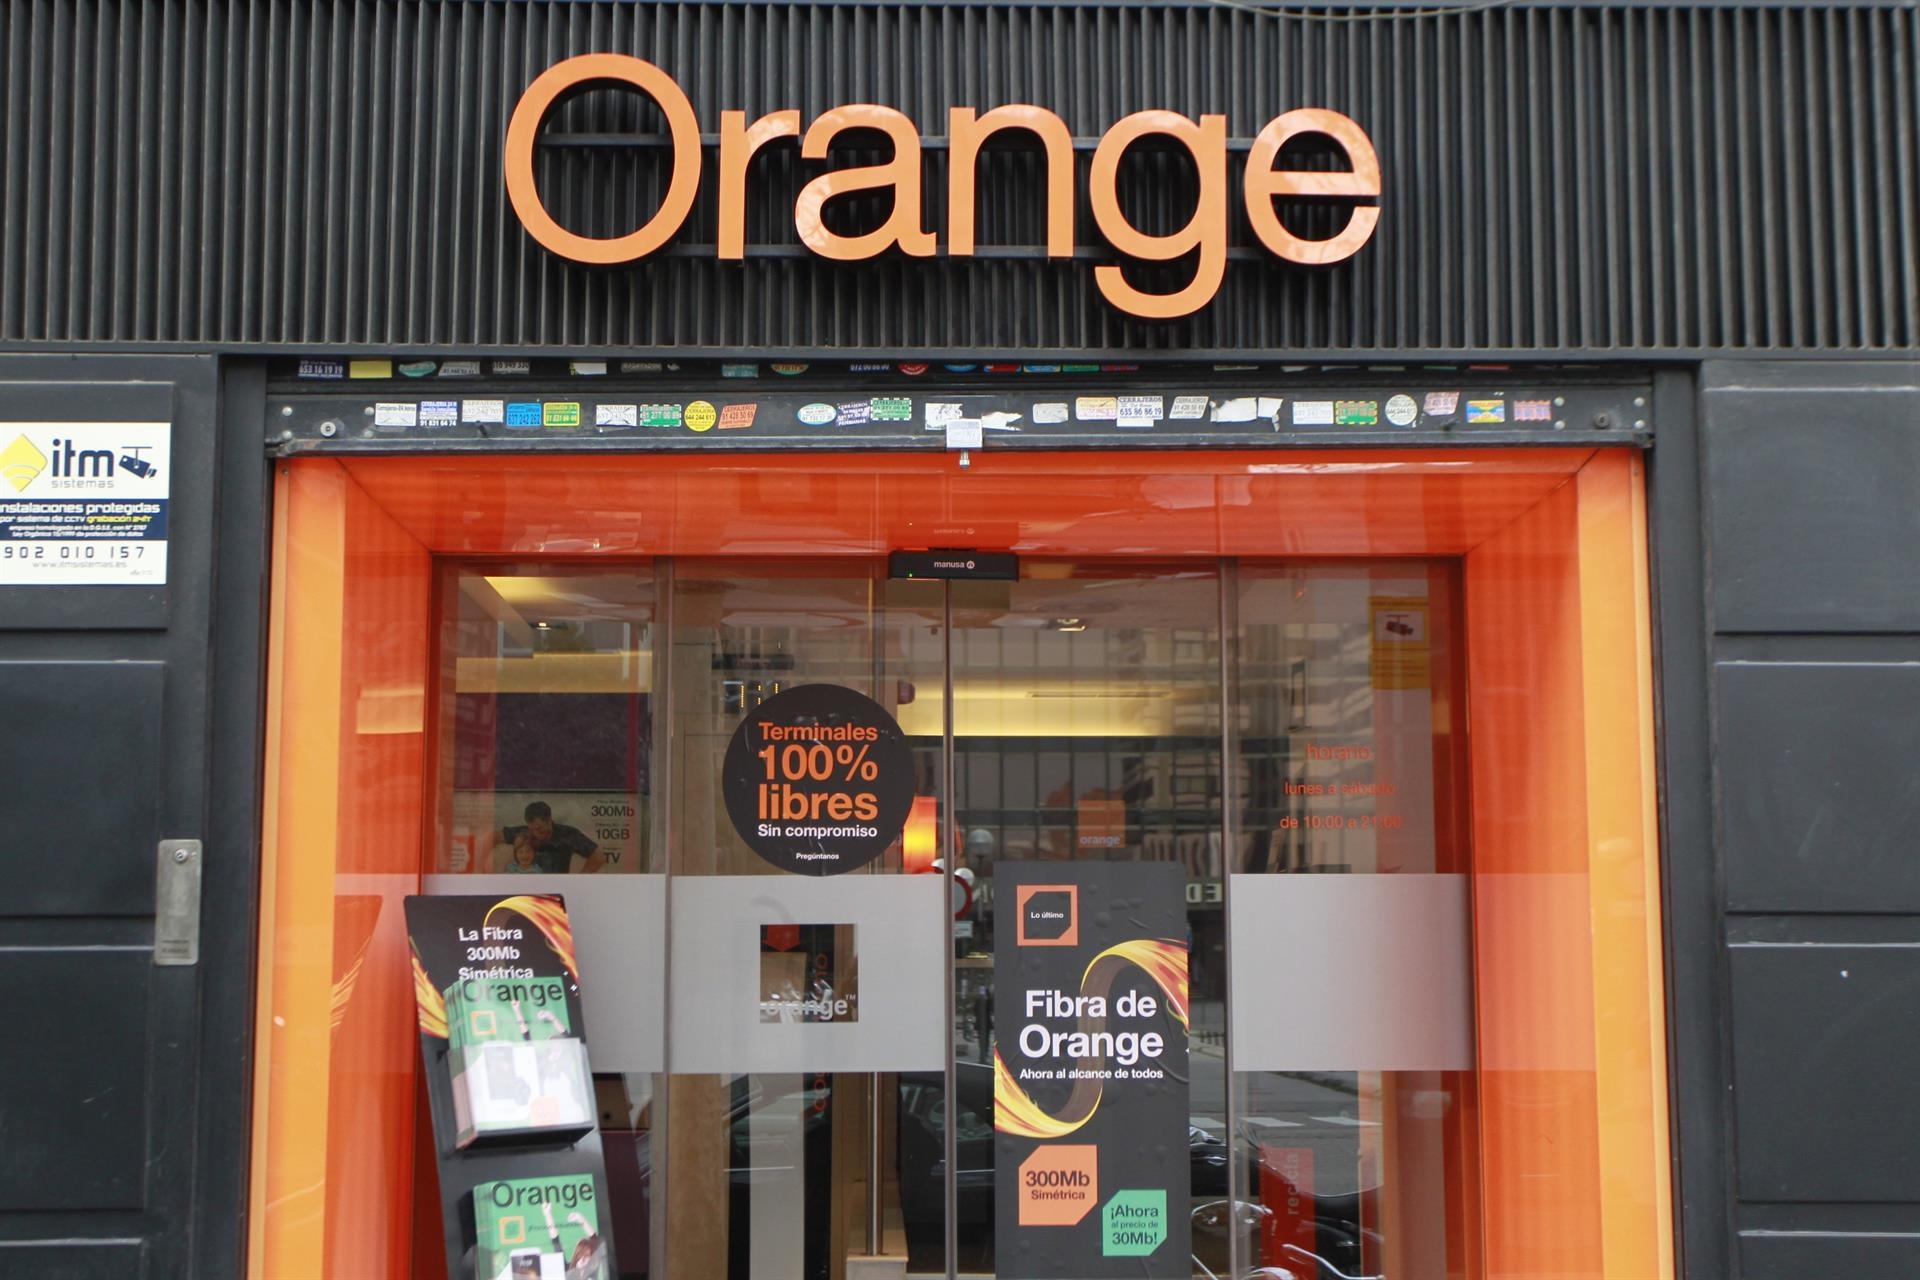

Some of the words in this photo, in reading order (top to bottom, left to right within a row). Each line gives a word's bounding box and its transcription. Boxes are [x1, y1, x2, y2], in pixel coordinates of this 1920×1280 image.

[505, 53, 1382, 318] Orange
[52, 439, 114, 477] itm
[51, 480, 114, 488] sistemas
[86, 503, 160, 515] protegidas
[4, 547, 44, 558] 902
[61, 547, 94, 558] 010
[111, 547, 144, 558] 157
[759, 722, 878, 740] Terminales
[759, 744, 878, 782] 100%
[1285, 781, 1323, 795] lunes
[759, 784, 878, 820] libres
[591, 805, 635, 817] 300Mb
[1280, 815, 1299, 829] de
[1304, 815, 1344, 829] 10:00
[596, 829, 631, 840] 10GB
[758, 824, 781, 837] Sin
[785, 825, 878, 839] compromiso
[1080, 836, 1120, 848] orange
[604, 852, 621, 863] TV
[796, 852, 839, 860] Pregúntanos
[1041, 911, 1064, 919] último
[459, 928, 479, 941] La
[484, 926, 523, 940] Fibra
[468, 947, 520, 961] 300Mb
[459, 966, 534, 980] Simétrica
[463, 978, 563, 1007] Orange
[1026, 990, 1107, 1017] Fibra
[1116, 990, 1157, 1017] de
[1019, 1024, 1164, 1065] Orange
[1020, 1069, 1054, 1079] Ahora
[1056, 1068, 1066, 1079] al
[1069, 1068, 1112, 1079] alcance
[1115, 1068, 1129, 1079] de
[1132, 1068, 1163, 1079] todos
[1025, 1170, 1090, 1187] 300Mb
[492, 1182, 593, 1208] Orange
[1031, 1190, 1085, 1200] Simétrica
[1110, 1204, 1159, 1220] ¡Ahora
[1111, 1220, 1119, 1228] al
[1120, 1220, 1145, 1230] precio
[1147, 1220, 1159, 1228] de
[1112, 1232, 1158, 1245] 30Mb!
